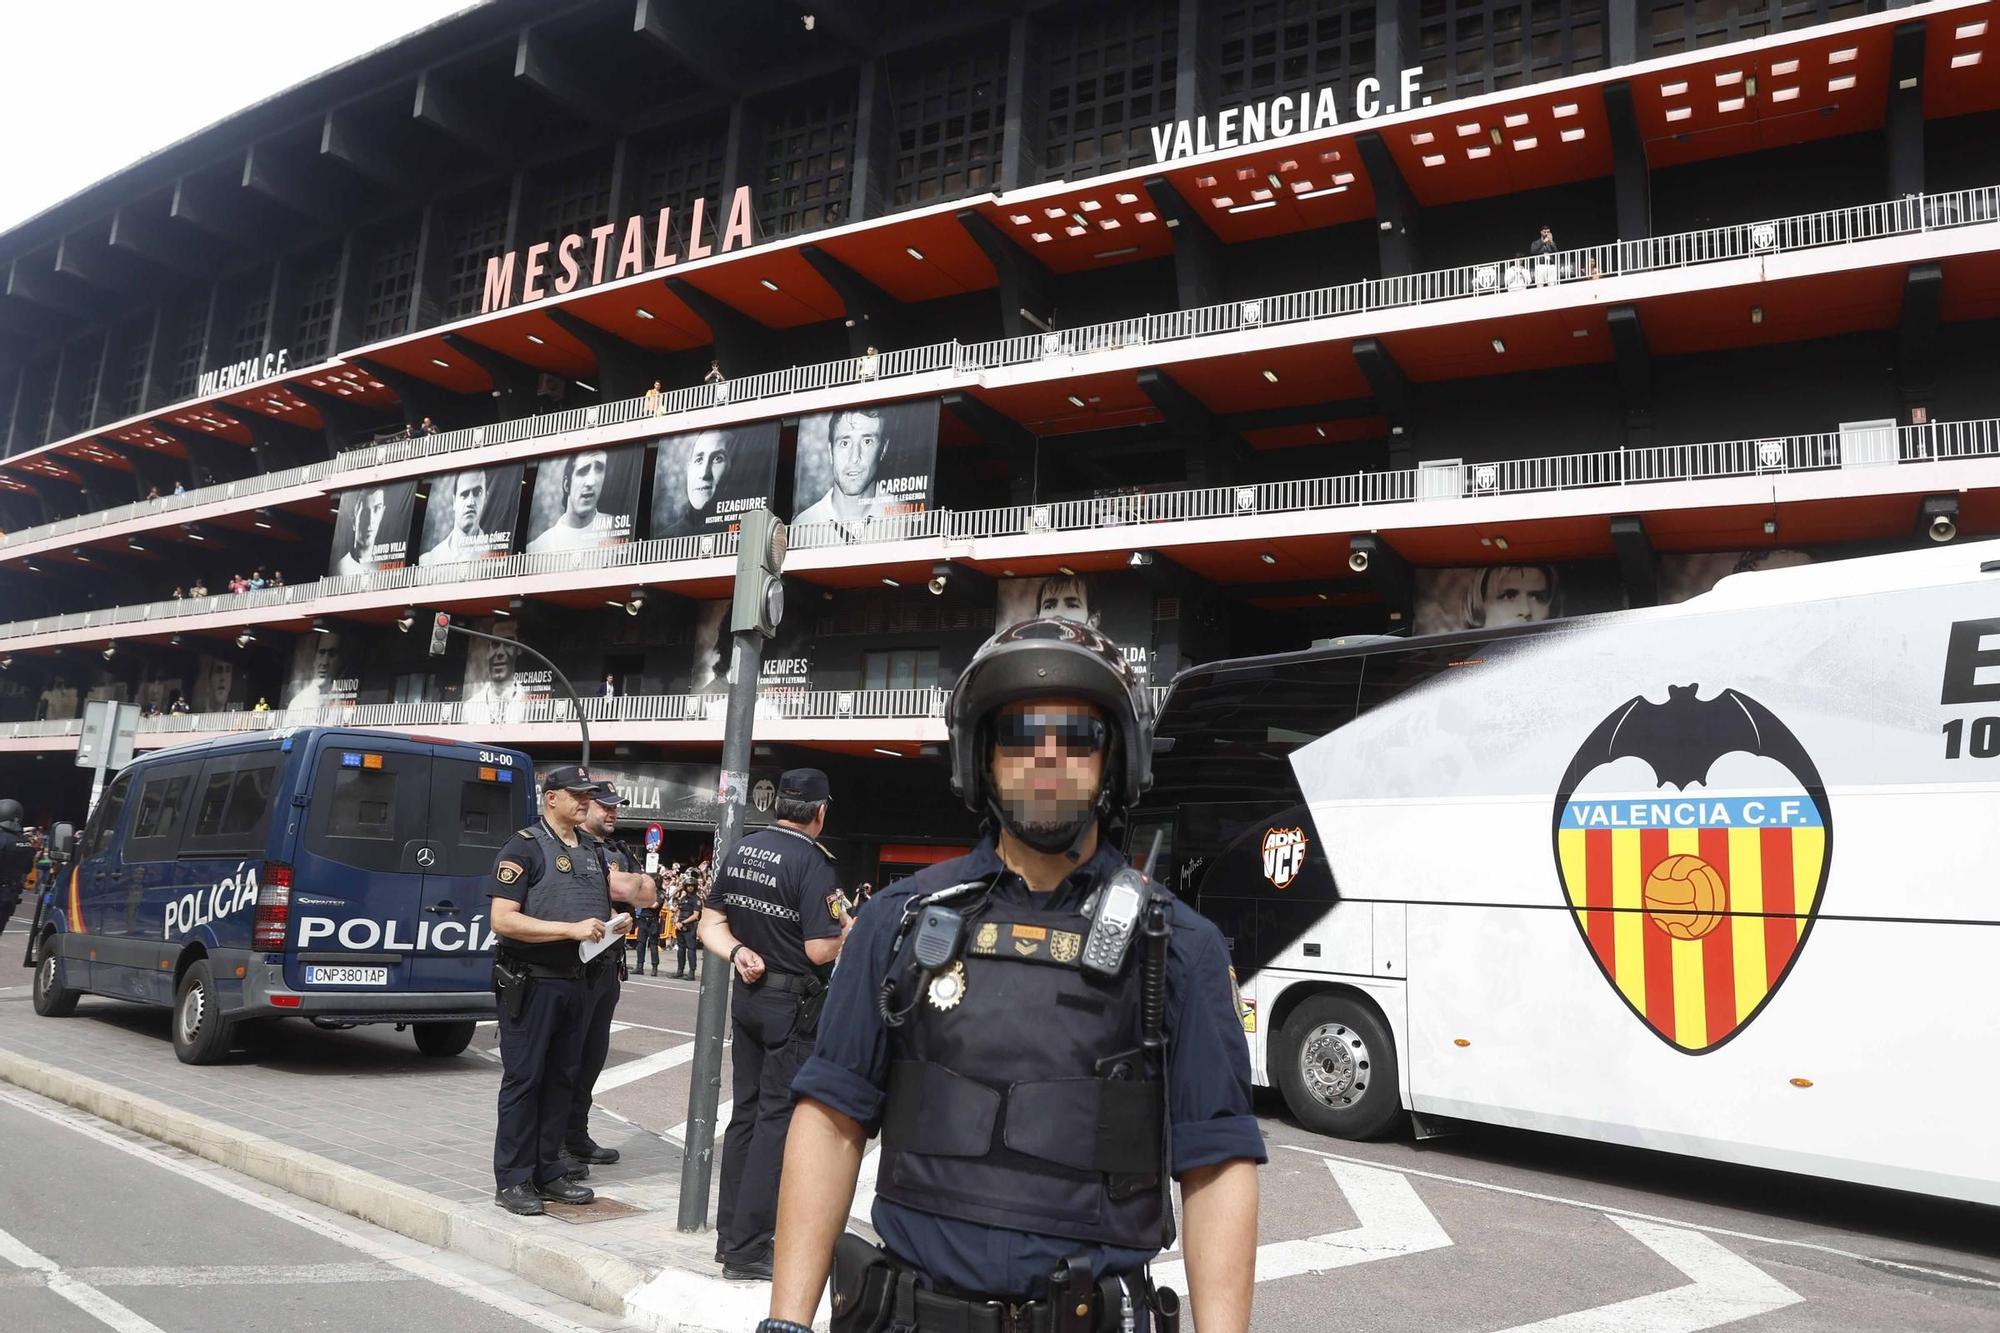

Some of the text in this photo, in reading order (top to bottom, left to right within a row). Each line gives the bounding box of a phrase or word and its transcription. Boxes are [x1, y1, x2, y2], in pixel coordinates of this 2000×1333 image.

[1151, 66, 1432, 163] VALENCIA C.F.
[481, 185, 752, 314] MESTALLA
[198, 348, 288, 398] VALENCIA C.F.
[880, 475, 928, 494] CARBONI
[716, 497, 768, 514] EIZAGUIRRE
[592, 514, 631, 530] JUAN SOL
[490, 530, 511, 543] GÓMEZ
[391, 541, 406, 553] VILLA
[763, 658, 808, 675] KEMPES
[1941, 617, 2000, 705] E
[513, 671, 553, 684] PUCHADES
[1942, 716, 2000, 759] 10
[480, 751, 513, 766] 3U-00
[616, 786, 661, 809] TALLA
[1572, 801, 1807, 826] VALENCIA C.F.
[1265, 831, 1301, 850] ADN
[737, 845, 782, 865] POLICIA
[743, 857, 766, 870] LOCAL
[1264, 842, 1306, 884] VCF
[165, 861, 259, 940] POLICÍA
